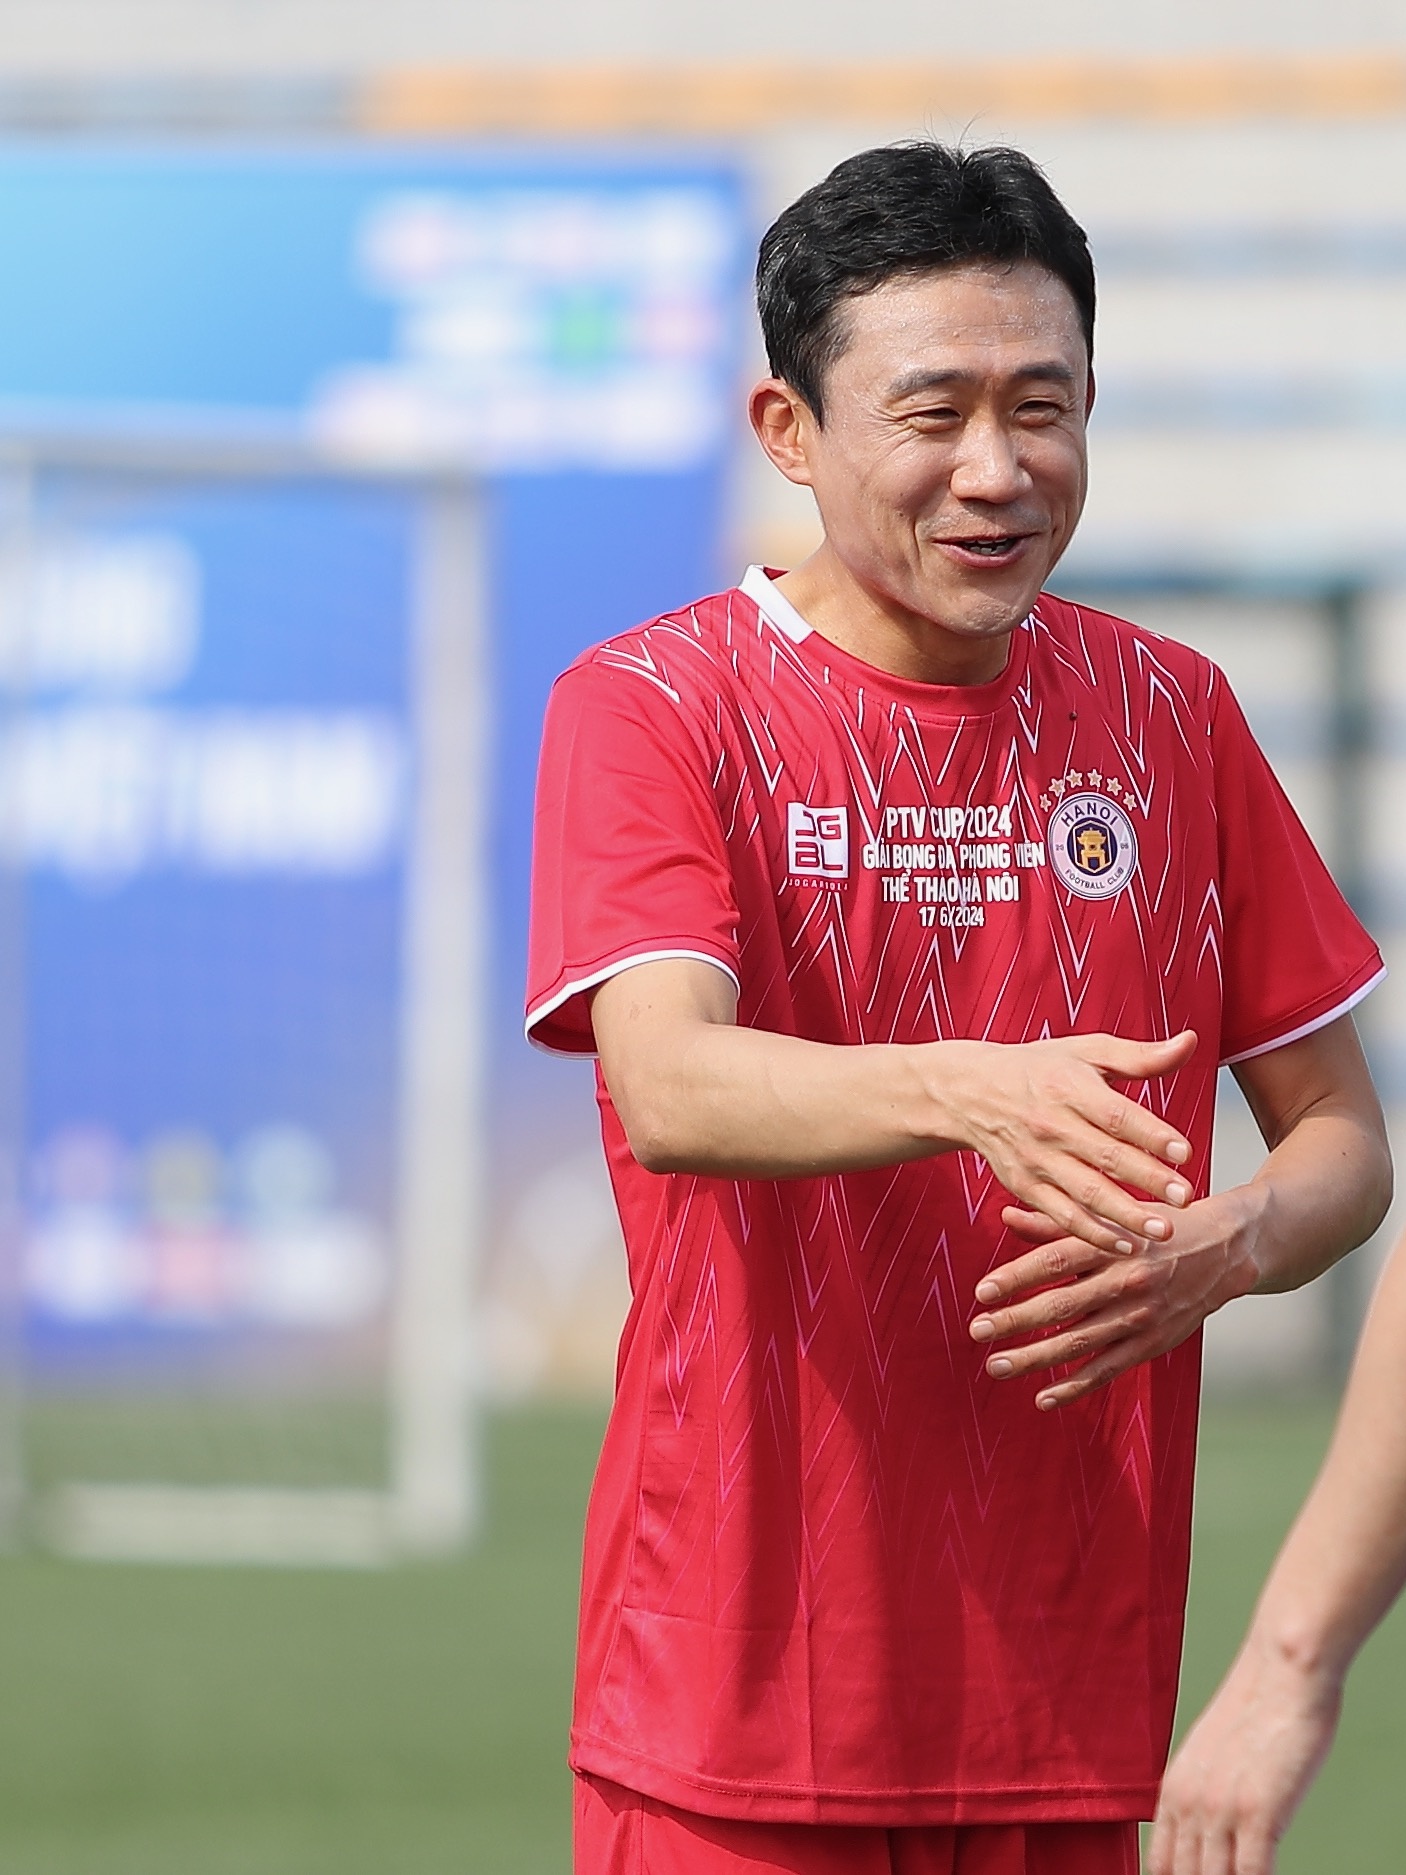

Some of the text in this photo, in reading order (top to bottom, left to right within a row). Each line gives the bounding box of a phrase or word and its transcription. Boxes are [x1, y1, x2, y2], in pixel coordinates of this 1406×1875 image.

[886, 805, 1012, 839] PTV CUP 2024
[1060, 802, 1118, 827] HANOI
[1065, 866, 1125, 889] FOOTBALL CLUB
